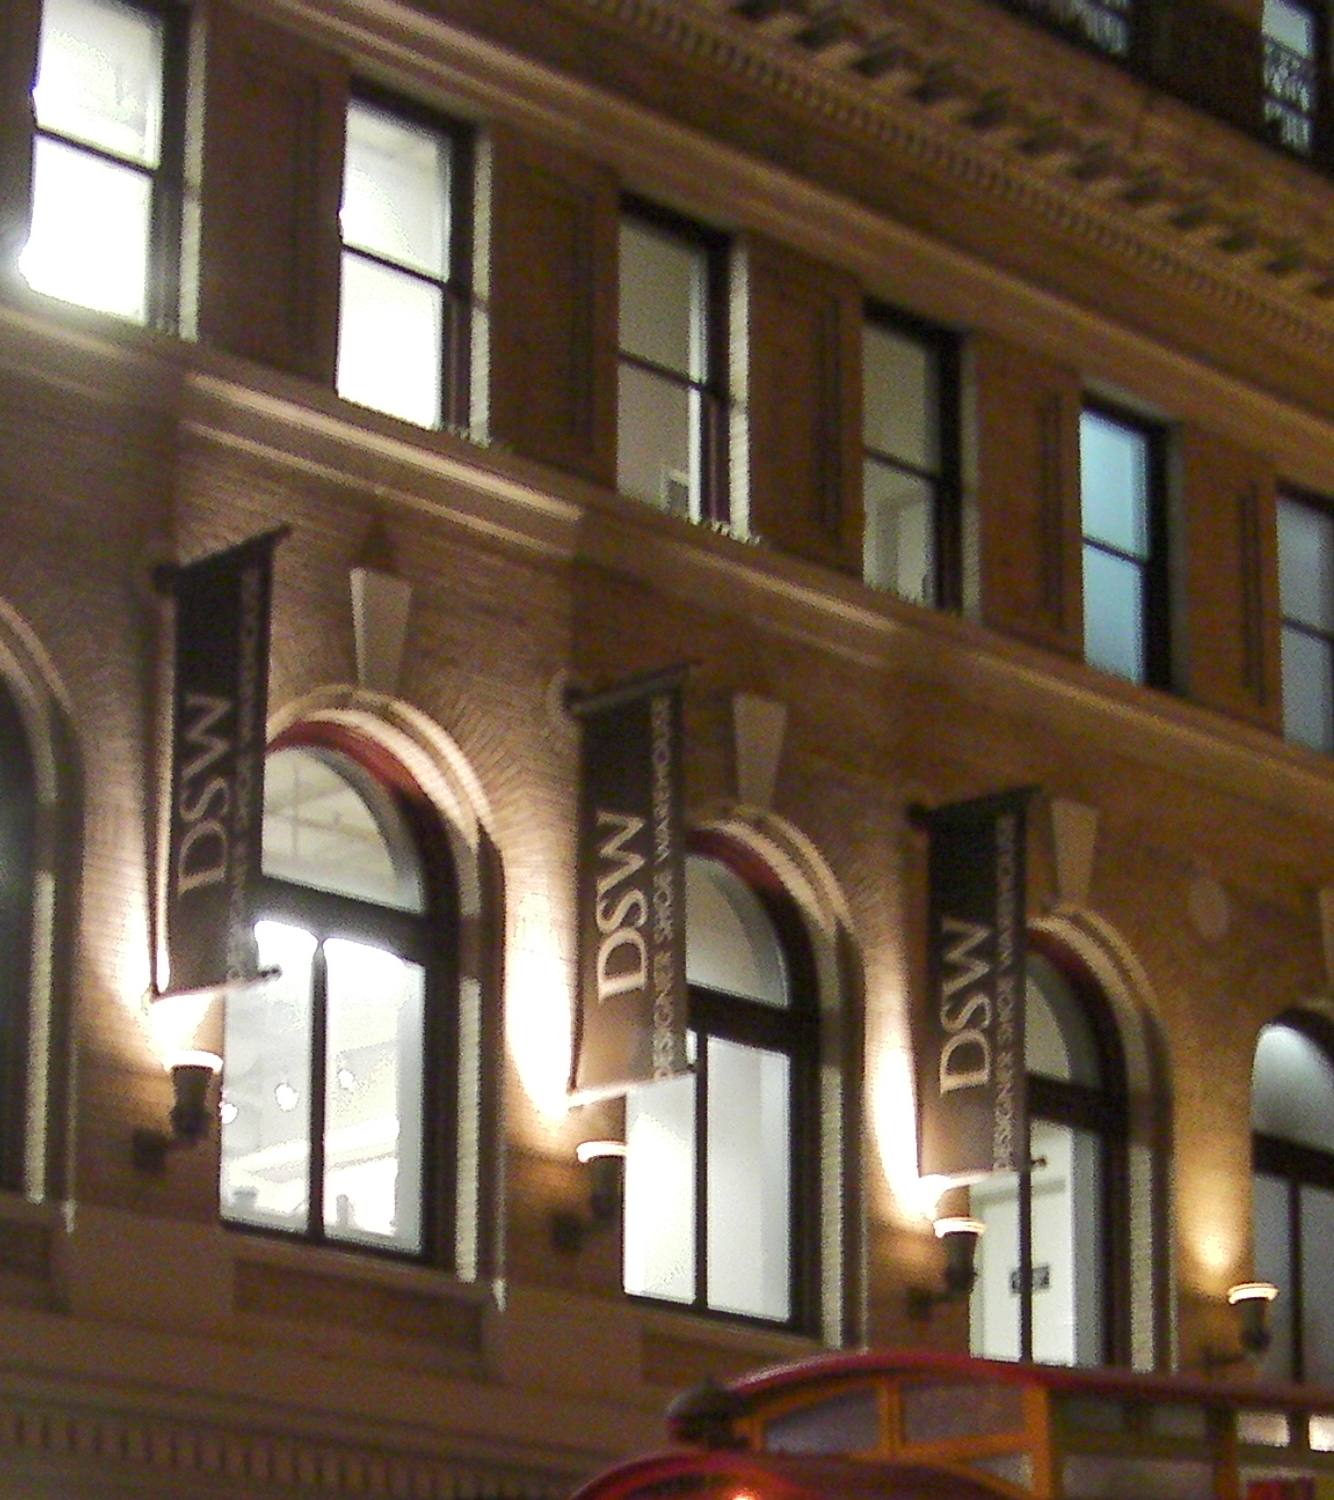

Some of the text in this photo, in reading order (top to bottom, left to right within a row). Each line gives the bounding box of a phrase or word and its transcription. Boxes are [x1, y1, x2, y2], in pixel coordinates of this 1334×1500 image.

[178, 692, 233, 900] DSW
[596, 810, 649, 1003] DSW
[652, 870, 672, 944] SHOE
[653, 950, 673, 1079] DESIGNER
[940, 916, 993, 1098] DSW
